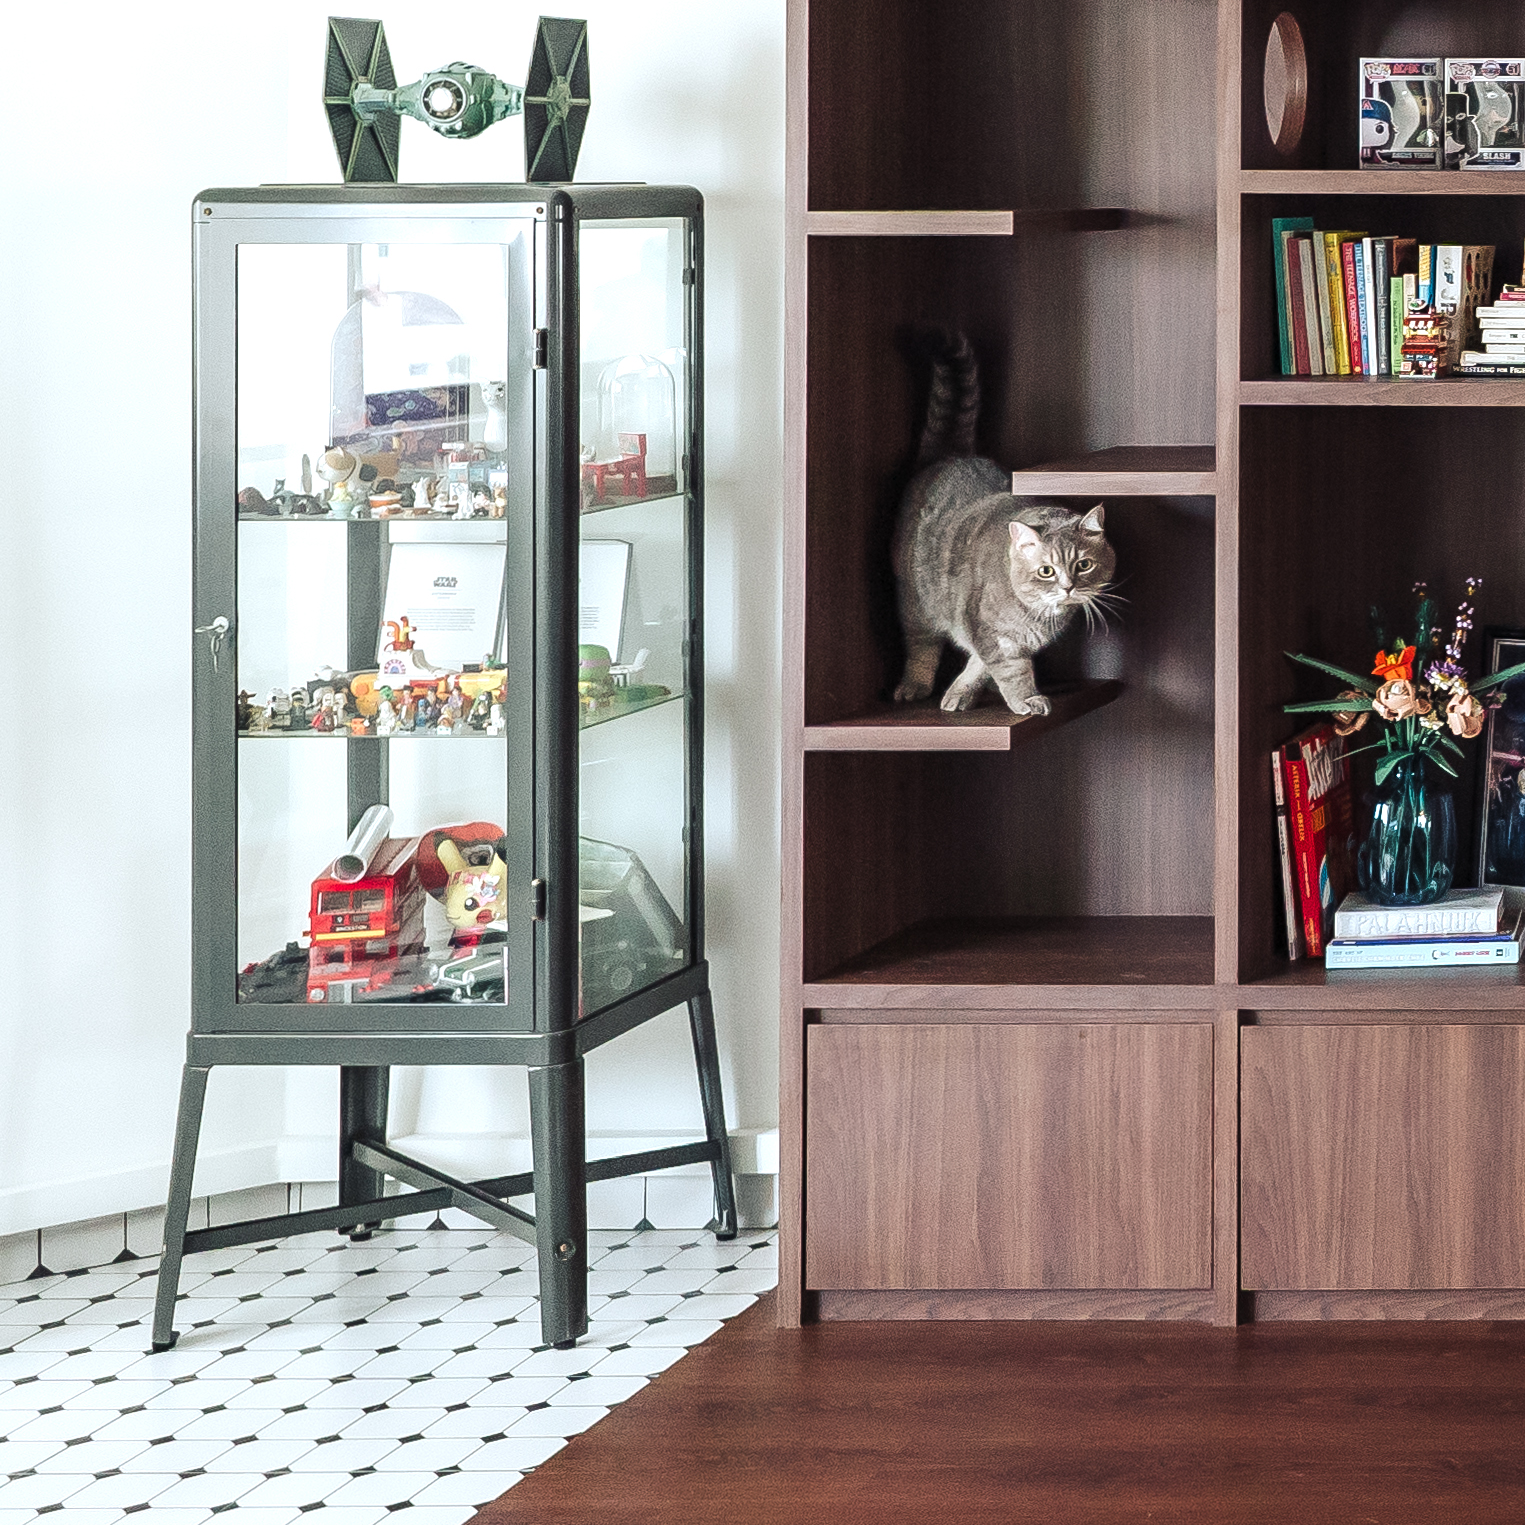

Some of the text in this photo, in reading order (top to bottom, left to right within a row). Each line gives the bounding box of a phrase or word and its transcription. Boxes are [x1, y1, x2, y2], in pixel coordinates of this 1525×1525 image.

[1507, 64, 1518, 74] 51
[1483, 152, 1511, 160] SLASH
[1292, 765, 1301, 799] ASTERIX
[1357, 911, 1482, 936] PALAHNIUK
